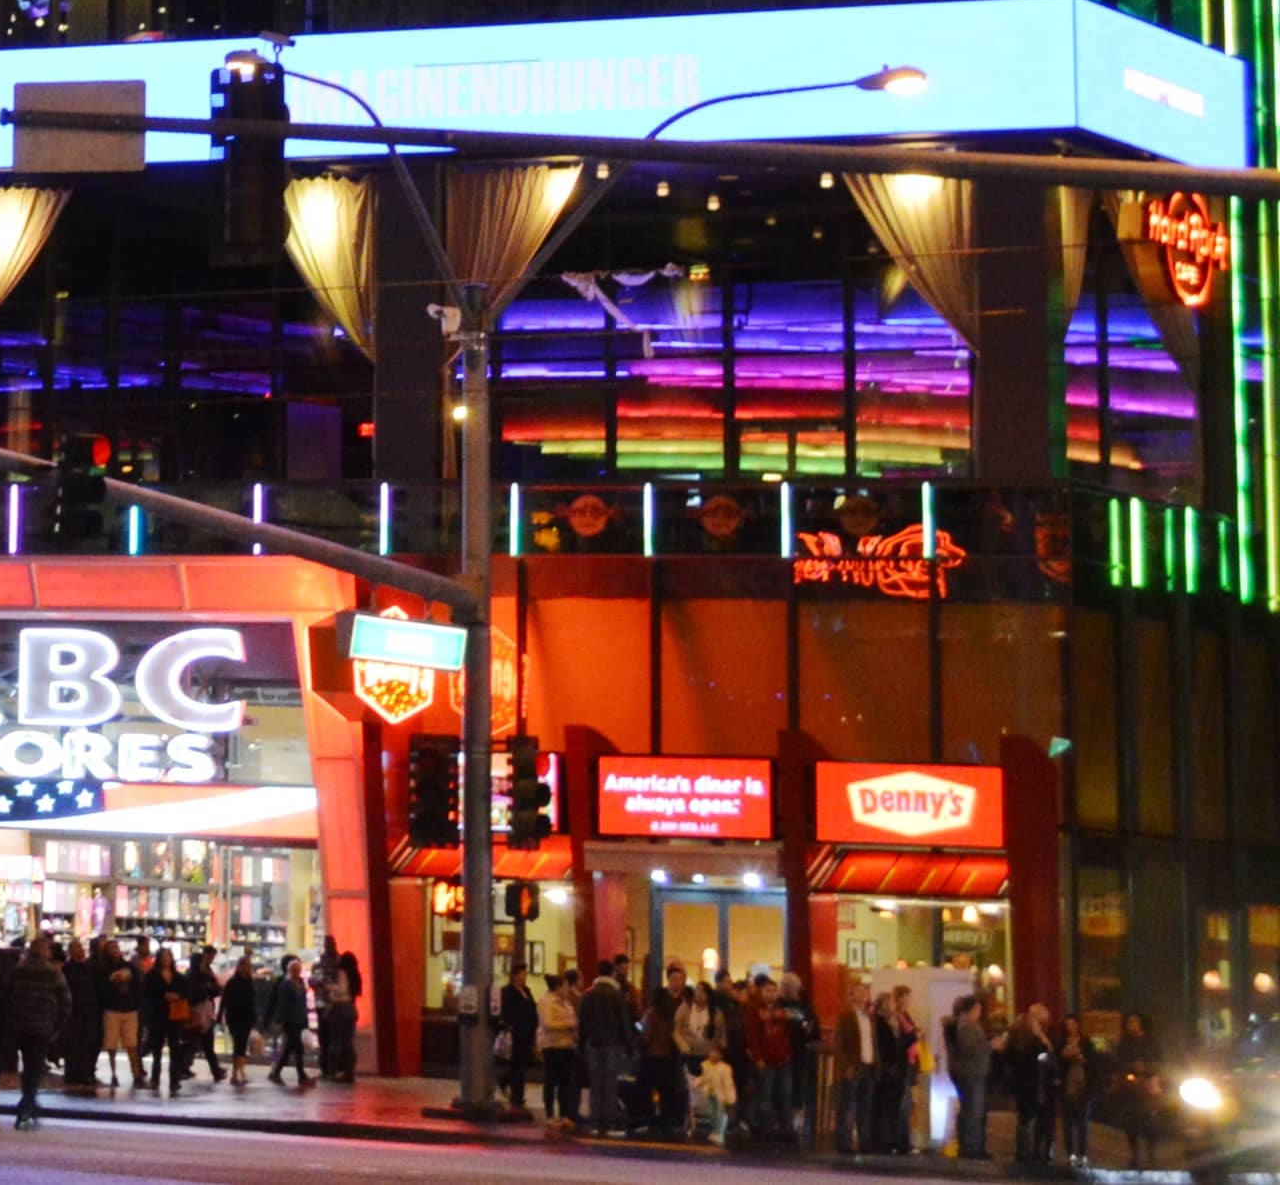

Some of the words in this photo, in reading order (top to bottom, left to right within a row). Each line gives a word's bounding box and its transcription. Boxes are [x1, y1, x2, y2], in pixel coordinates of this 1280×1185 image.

[604, 774, 690, 793] America's
[694, 775, 742, 794] diner
[744, 777, 765, 795] is
[625, 794, 686, 816] always
[859, 787, 965, 820] Denny's
